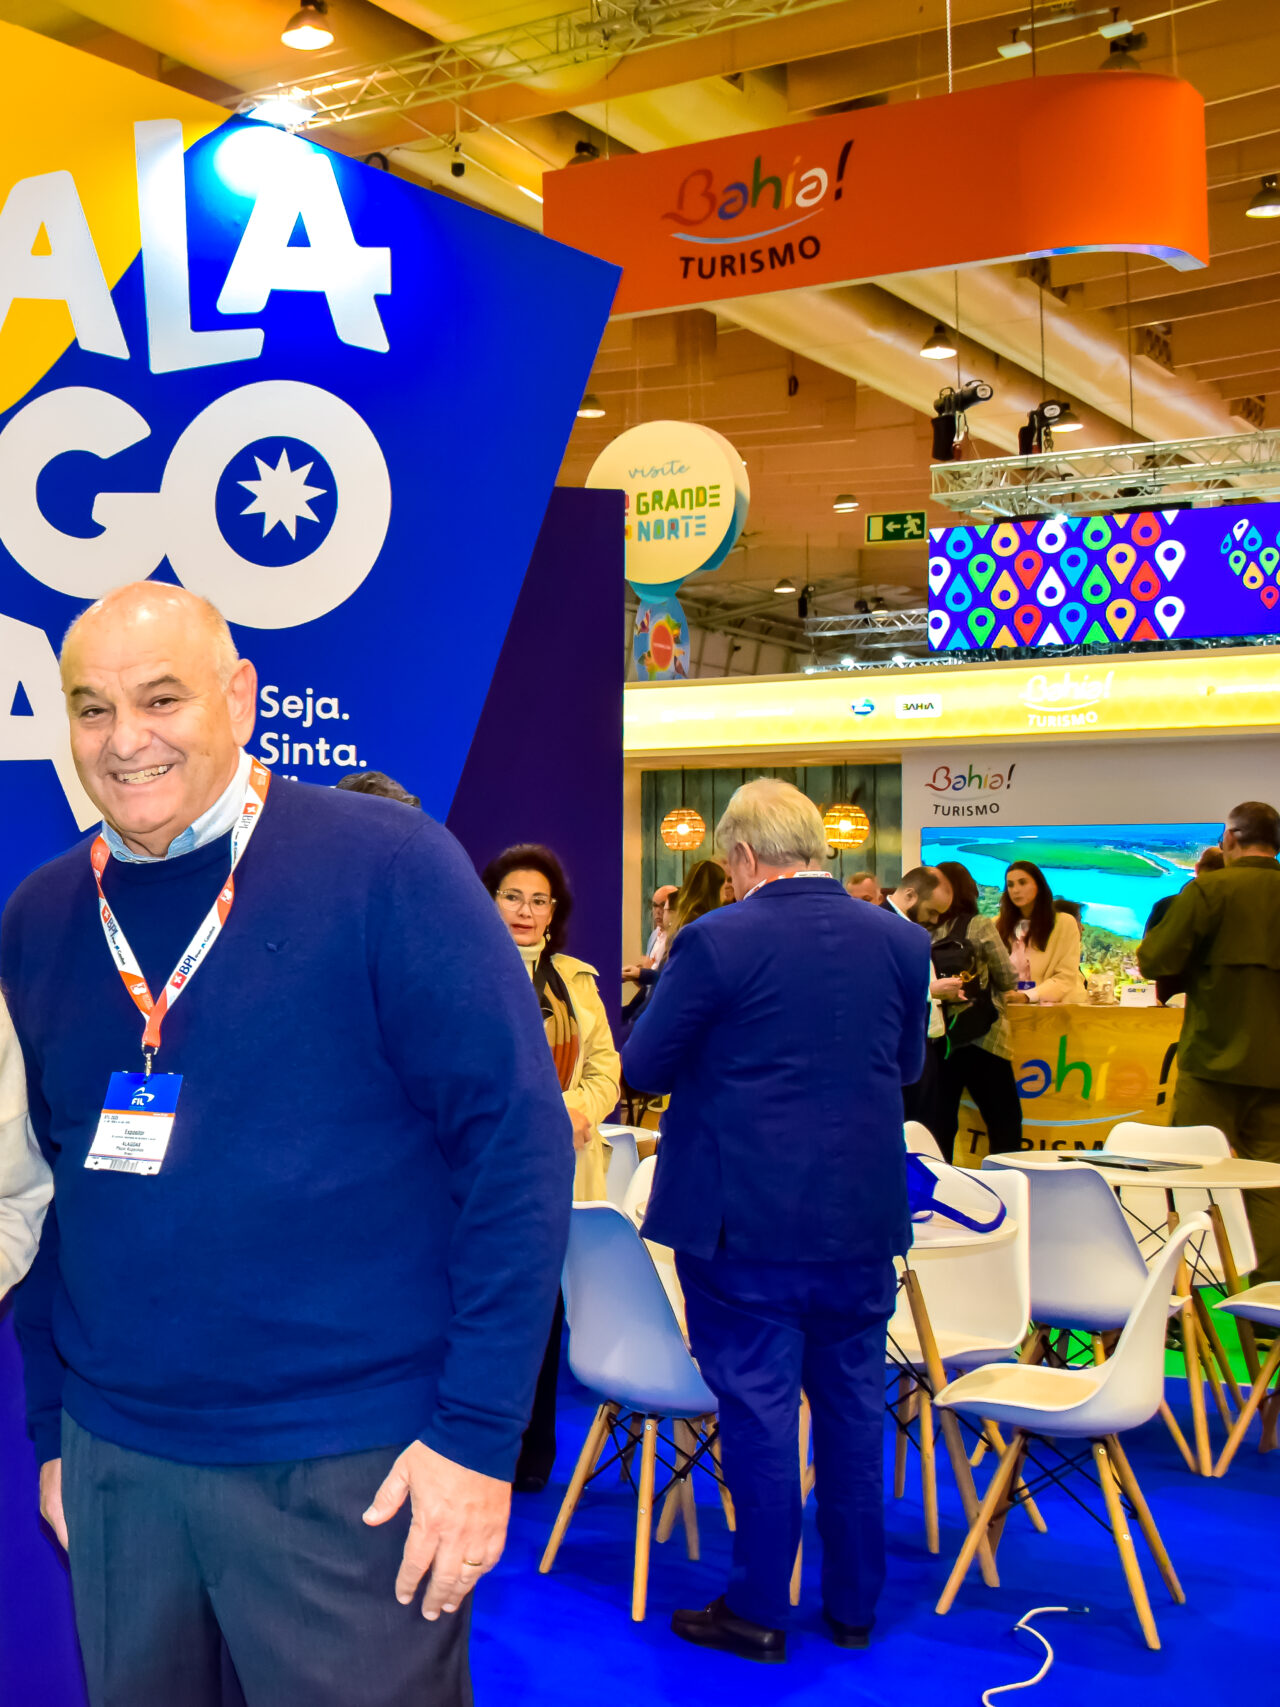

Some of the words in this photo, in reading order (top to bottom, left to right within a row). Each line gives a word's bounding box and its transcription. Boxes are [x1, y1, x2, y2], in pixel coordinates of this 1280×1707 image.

[661, 139, 854, 227] Bahia!
[680, 235, 821, 279] TURISMO
[628, 460, 691, 479] visite
[636, 485, 721, 515] GRANDE
[638, 515, 706, 541] NORTE
[260, 685, 350, 728] Seja.
[1027, 711, 1098, 728] TURISMO
[260, 731, 367, 767] Sinta.
[925, 763, 1016, 791] Bahia!
[933, 802, 1000, 816] TURISMO
[179, 955, 197, 976] BPI
[1017, 1034, 1180, 1106] ahia!
[131, 1097, 145, 1106] FIL
